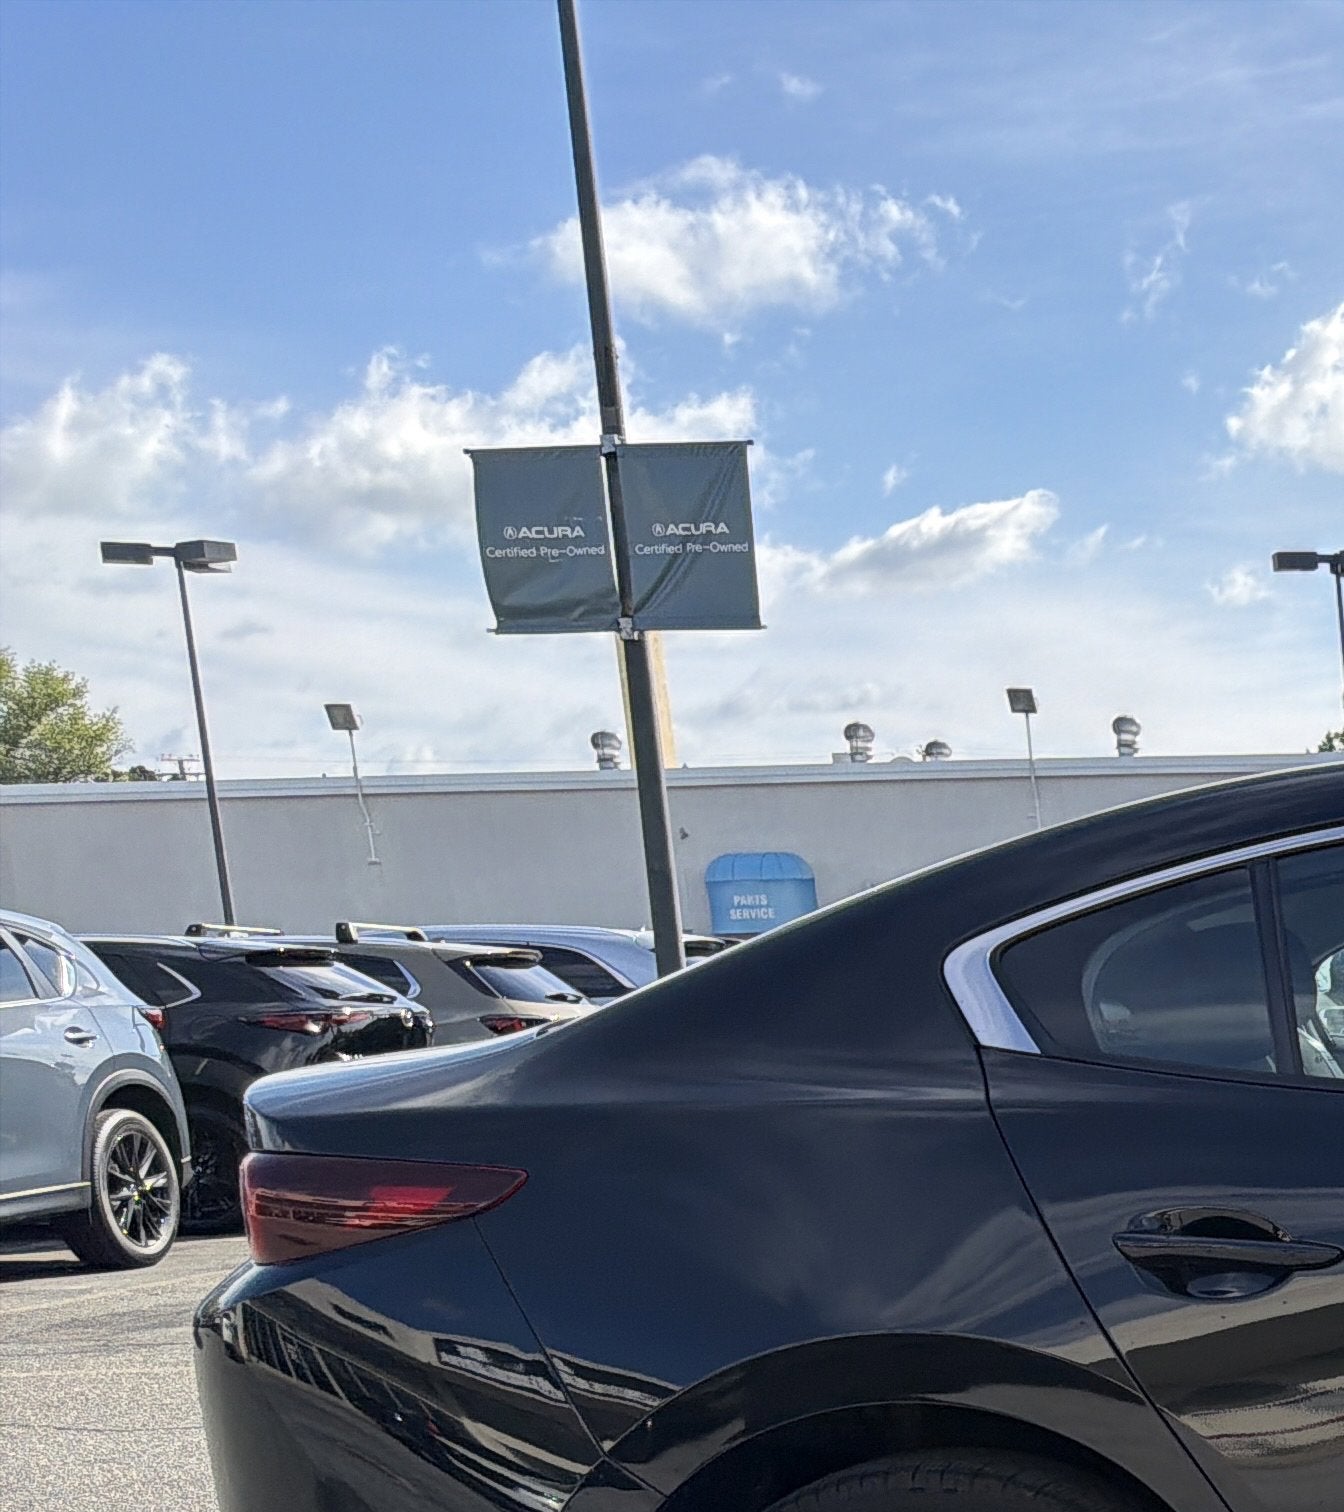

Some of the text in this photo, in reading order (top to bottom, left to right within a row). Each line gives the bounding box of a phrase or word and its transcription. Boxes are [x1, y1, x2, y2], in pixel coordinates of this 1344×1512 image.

[518, 525, 585, 539] ACURA
[666, 522, 730, 536] ACURA
[486, 544, 605, 558] Certified Pre-Owned
[634, 541, 749, 555] Certified Pre-Owned
[733, 894, 768, 907] PARTS
[729, 907, 776, 920] SERVICE
